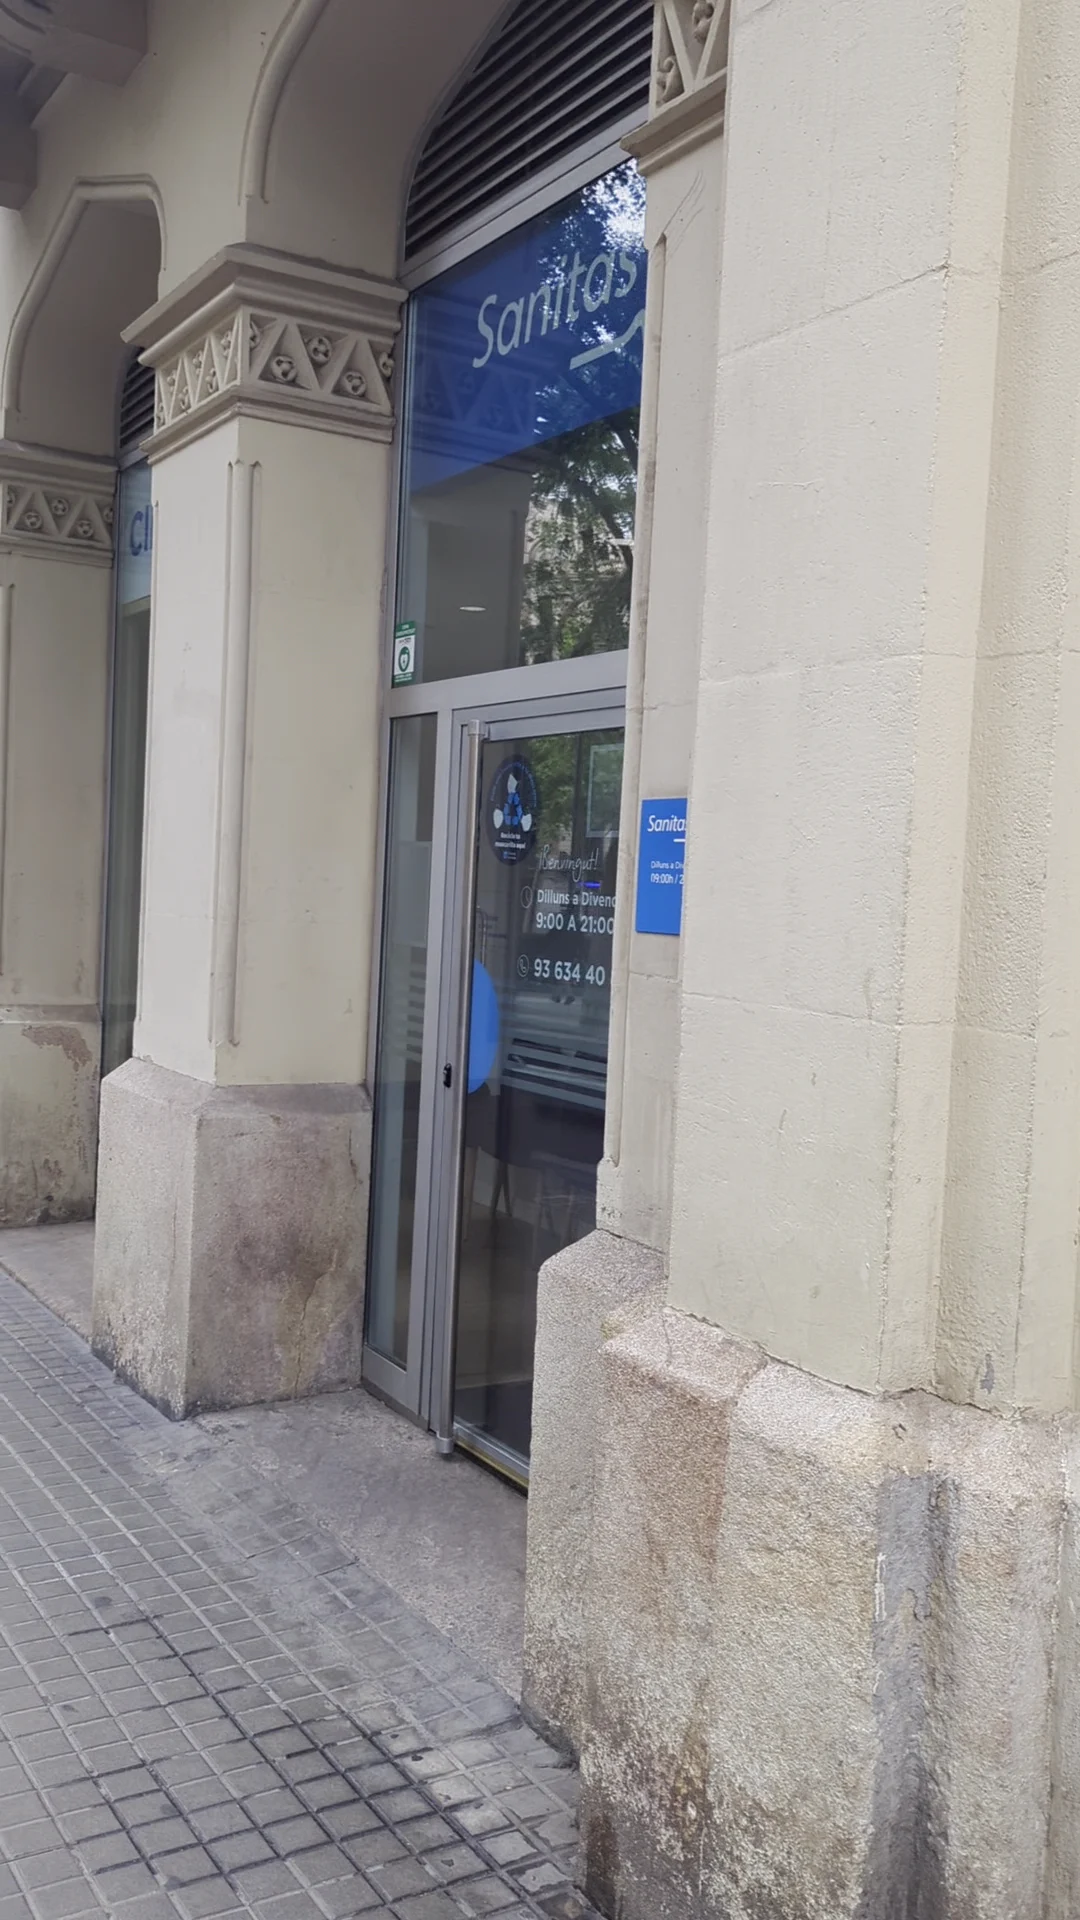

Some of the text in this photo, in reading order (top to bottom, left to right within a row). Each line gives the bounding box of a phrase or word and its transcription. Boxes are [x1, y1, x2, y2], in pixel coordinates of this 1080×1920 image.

[472, 250, 638, 368] Sanitas
[647, 814, 687, 832] Sanita
[537, 889, 570, 905] Dilluns
[572, 893, 579, 905] a
[536, 912, 615, 935] 9:00 A 21:00
[534, 958, 606, 986] 93 634 40
